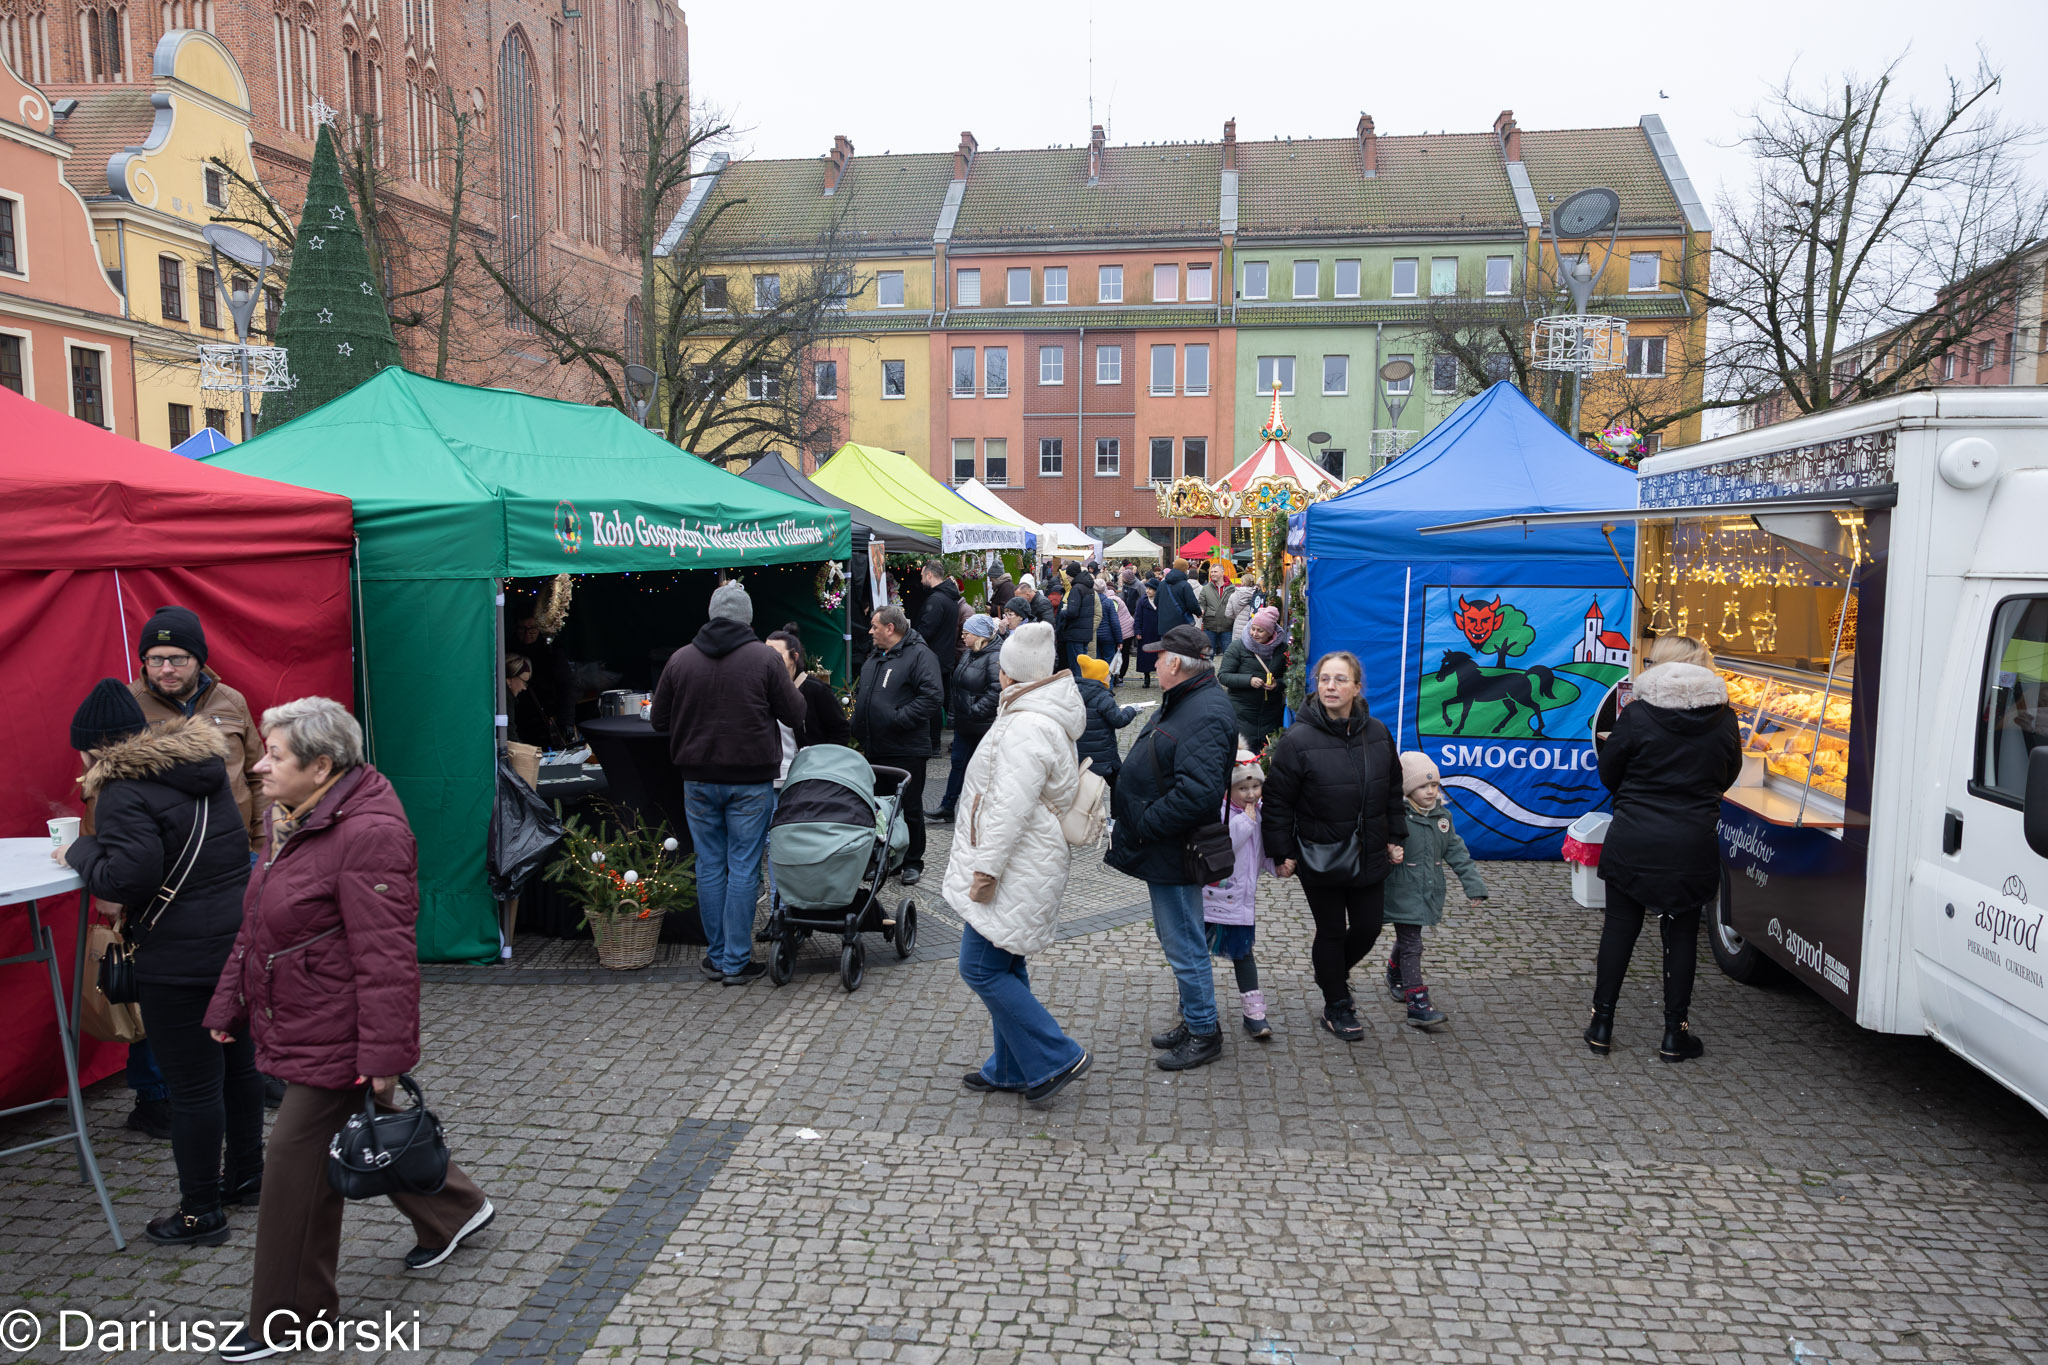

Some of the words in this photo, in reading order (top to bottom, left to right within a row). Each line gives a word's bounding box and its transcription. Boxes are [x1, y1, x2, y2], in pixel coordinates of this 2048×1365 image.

[590, 509, 635, 547] Koło
[635, 514, 712, 557] Gospodyń
[704, 521, 772, 557] Wiejskich
[766, 529, 782, 547] w
[777, 518, 824, 546] Ulikowie
[1441, 744, 1598, 771] SMOGOLIC
[1724, 823, 1776, 863] wypieków
[1746, 862, 1757, 879] od
[1975, 900, 2044, 953] asprod
[1785, 928, 1823, 974] asprod
[1824, 952, 1850, 981] PIEKARNIA
[1967, 938, 2002, 967] PIEKARNIA
[2004, 957, 2044, 989] CUKIERNIA
[1823, 965, 1849, 995] CUKIERNIA
